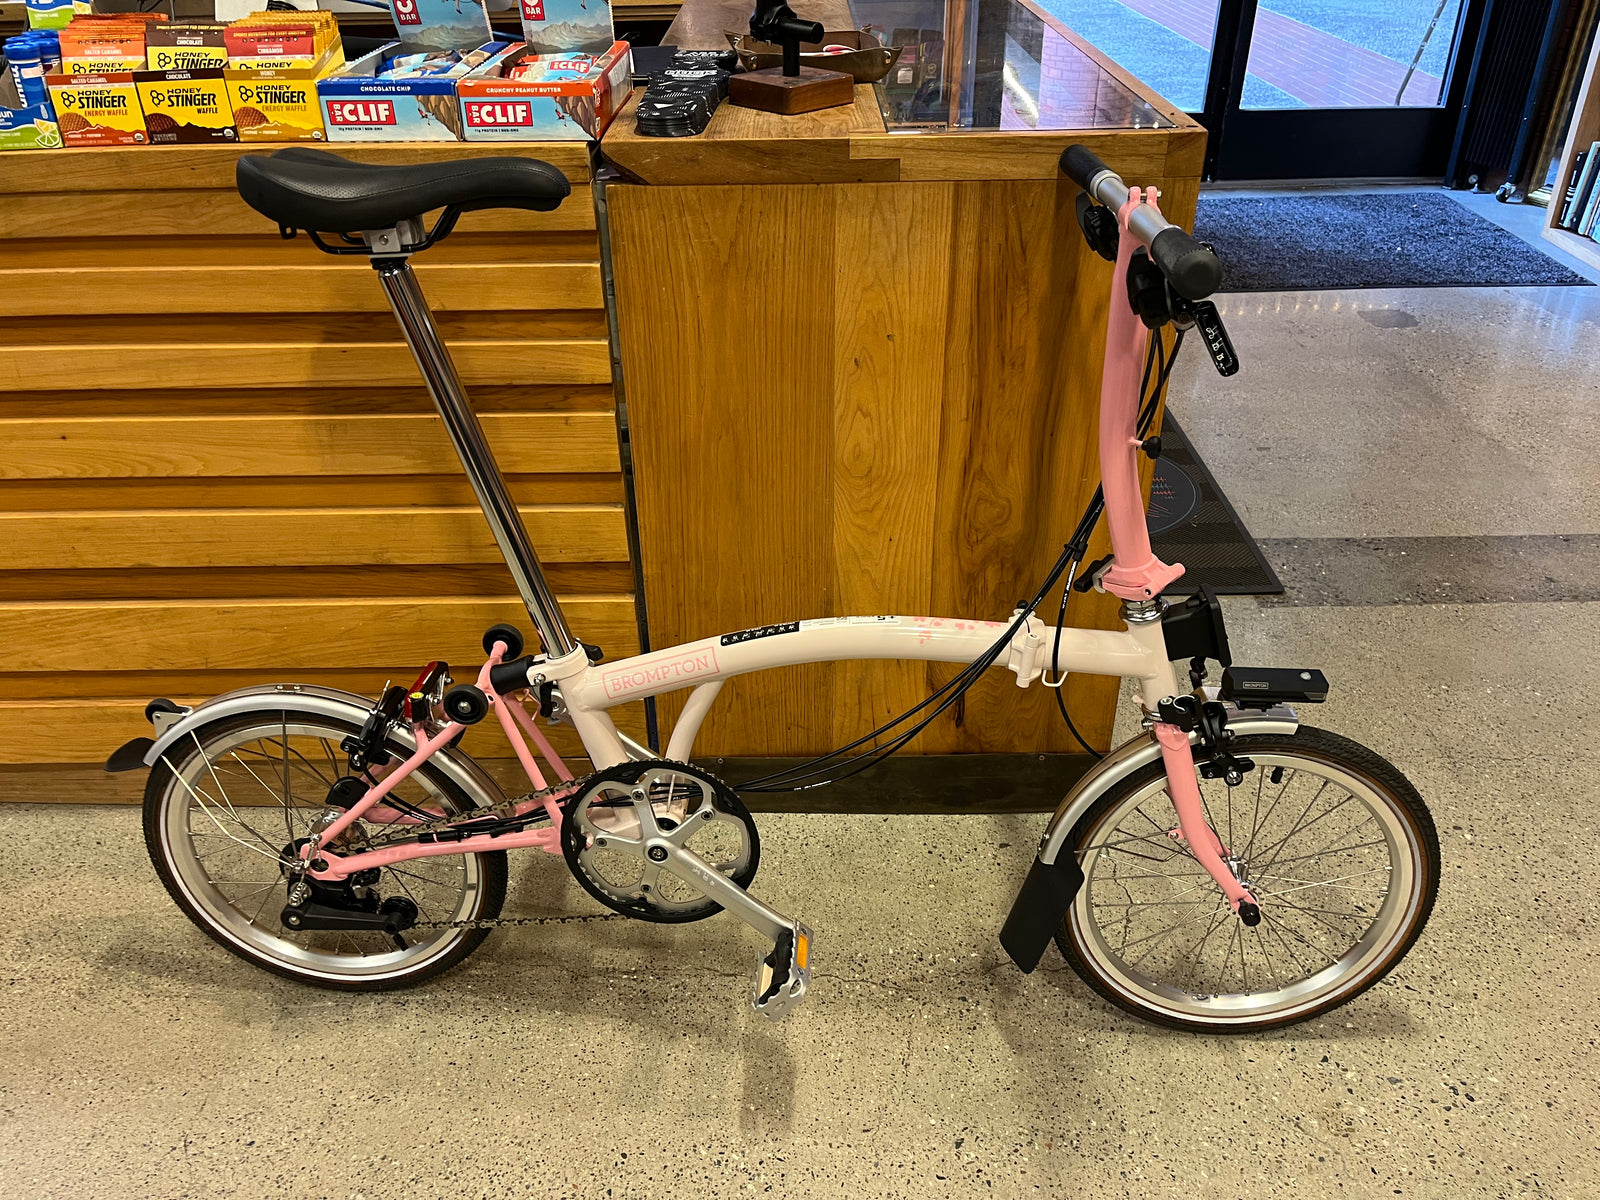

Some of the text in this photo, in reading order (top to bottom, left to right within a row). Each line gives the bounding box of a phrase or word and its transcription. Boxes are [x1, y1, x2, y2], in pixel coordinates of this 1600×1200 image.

[559, 62, 587, 72] CLIF
[11, 66, 28, 108] nuun
[78, 95, 126, 108] STINGER
[168, 93, 216, 107] STINGER
[256, 91, 306, 104] STINGER
[333, 104, 343, 122] BAR
[343, 104, 390, 122] CLIF
[471, 106, 480, 123] BAR
[480, 105, 527, 123] CLIF
[611, 656, 709, 692] BROMPTON
